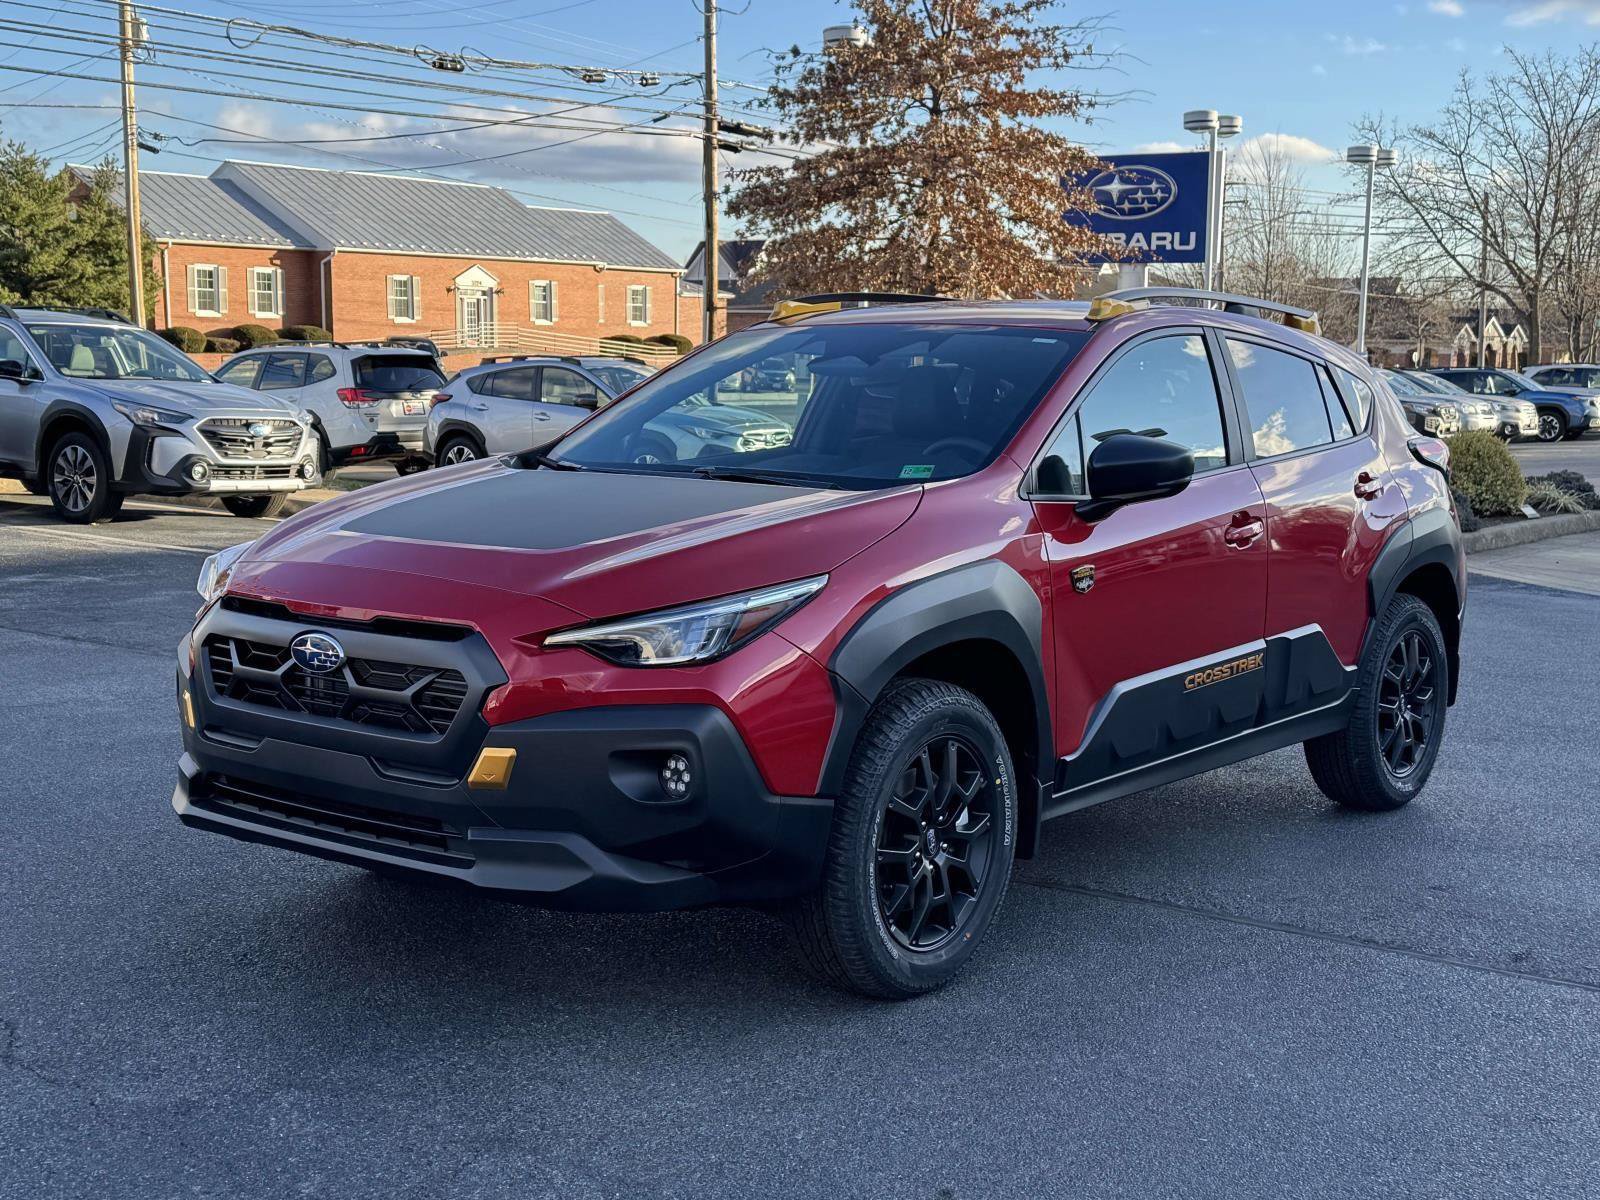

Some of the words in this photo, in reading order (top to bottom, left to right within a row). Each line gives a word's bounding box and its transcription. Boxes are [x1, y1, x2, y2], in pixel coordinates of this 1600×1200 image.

[1097, 231, 1196, 251] BARU
[1184, 653, 1263, 689] CROSSTREK
[995, 754, 1011, 847] YOKOHAMA
